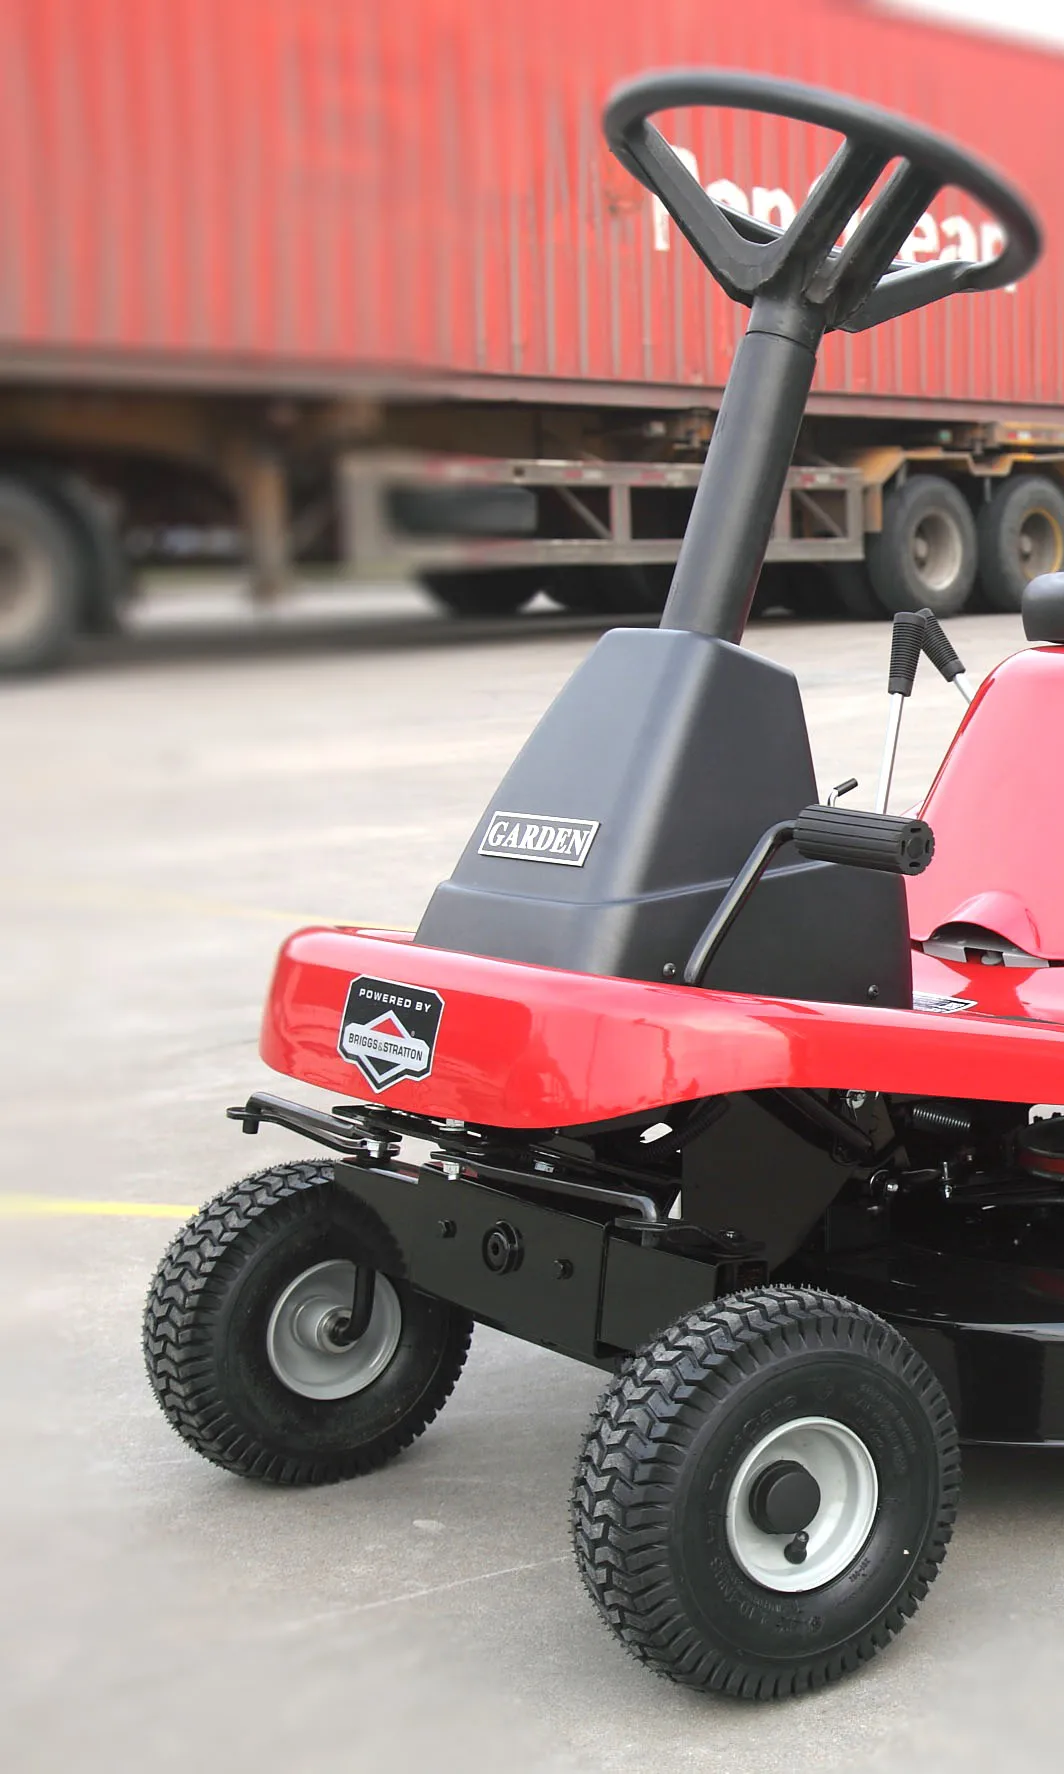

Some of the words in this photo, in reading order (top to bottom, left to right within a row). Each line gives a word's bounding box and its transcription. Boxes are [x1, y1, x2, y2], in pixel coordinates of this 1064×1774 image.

[487, 820, 591, 856] GARDEN
[358, 988, 412, 1009] POWERED
[414, 1001, 432, 1013] BY
